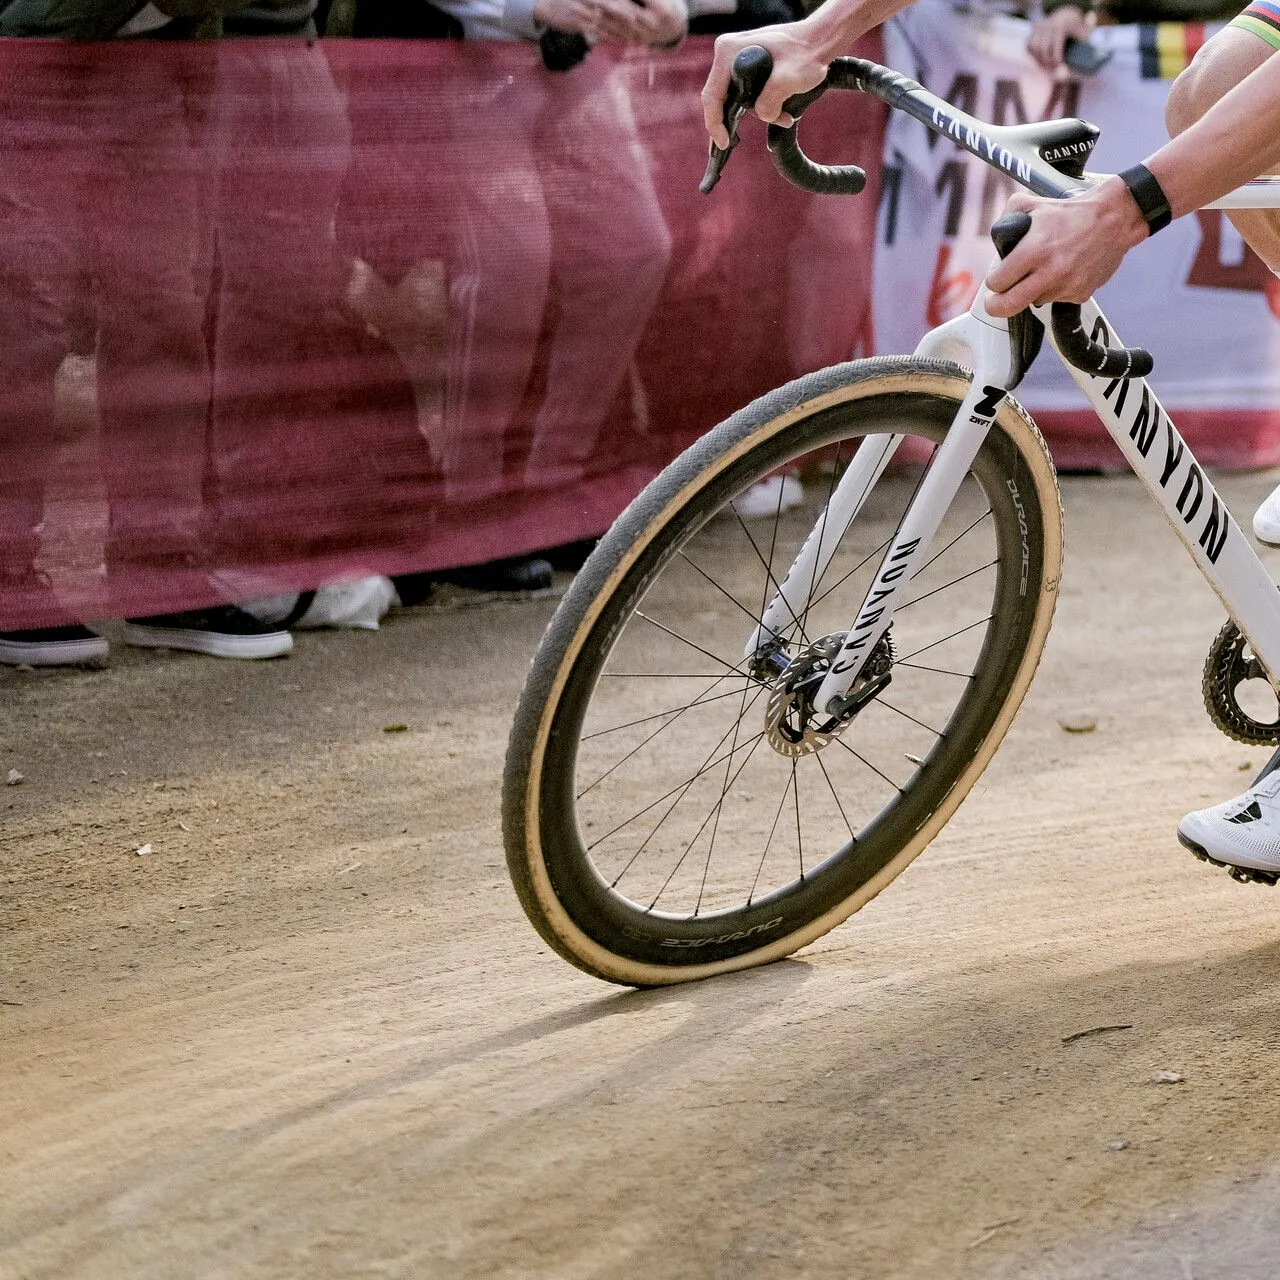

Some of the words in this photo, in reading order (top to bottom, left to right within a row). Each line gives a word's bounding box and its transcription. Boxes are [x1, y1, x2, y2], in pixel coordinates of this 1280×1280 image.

[932, 107, 1032, 183] CANYON
[1044, 139, 1095, 162] CANYON
[968, 415, 991, 428] ZWIFT
[1006, 478, 1031, 597] DURA-ACE
[832, 536, 922, 675] CANYON
[1045, 576, 1058, 593] 33
